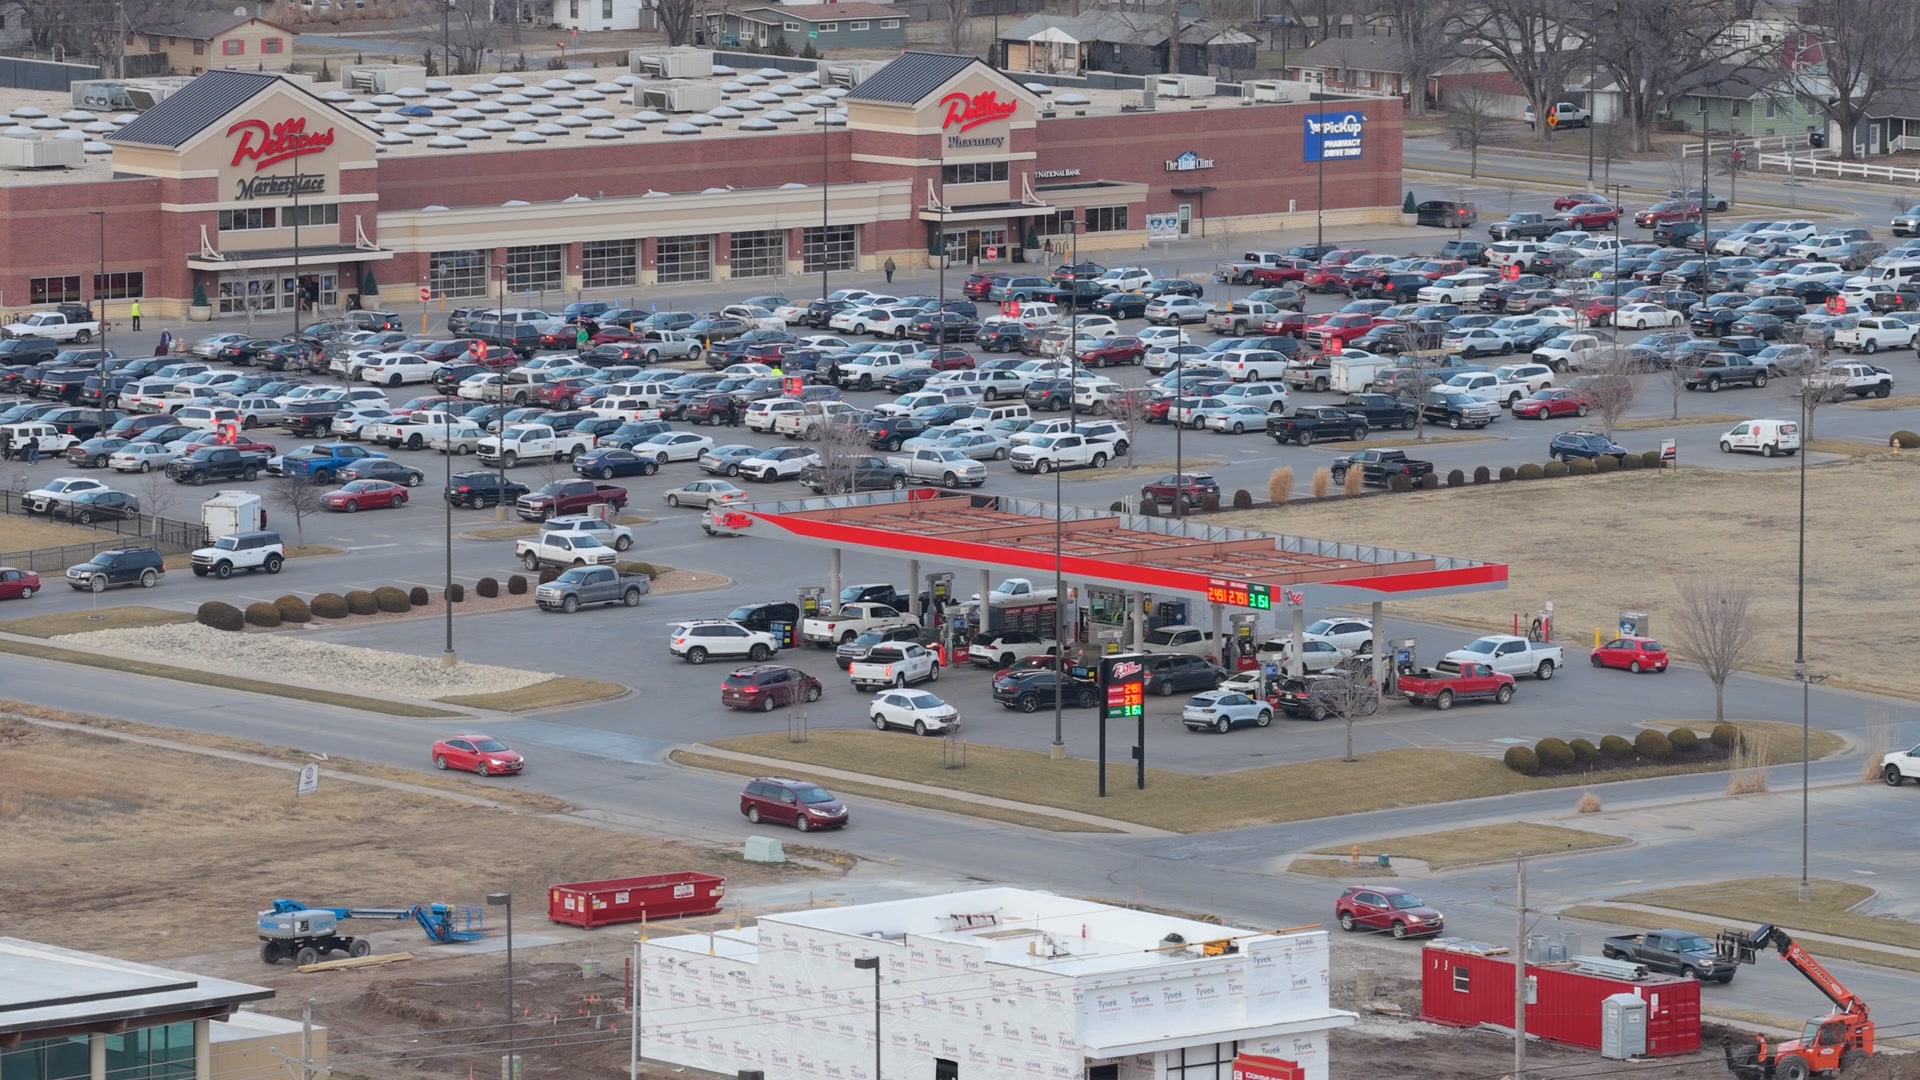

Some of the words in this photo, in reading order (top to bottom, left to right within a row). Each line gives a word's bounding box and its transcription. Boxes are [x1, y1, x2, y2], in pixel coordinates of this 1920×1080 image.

[939, 90, 1018, 133] Dillons
[226, 117, 335, 172] Dillons
[948, 136, 1004, 148] Pharmacy
[1324, 139, 1361, 149] PHARMACY
[1324, 149, 1344, 158] DRIVE
[1344, 148, 1361, 156] THRU
[1165, 160, 1178, 171] The
[1178, 160, 1196, 171] Little
[1196, 158, 1215, 169] Clinic
[1038, 170, 1066, 178] NATIONAL
[1066, 168, 1081, 176] BANK
[235, 173, 326, 199] Marketplace
[1112, 661, 1143, 679] Dillons
[1295, 938, 1315, 947] Tyvek
[1253, 955, 1273, 965] Tyvek
[1163, 990, 1183, 1001] Tyvek
[1196, 986, 1216, 996] Tyvek
[1098, 999, 1118, 1010] Tyvek
[1131, 995, 1150, 1005] Tyvek
[1294, 1042, 1313, 1051] Tyvek
[1136, 1055, 1153, 1066] Tyvek
